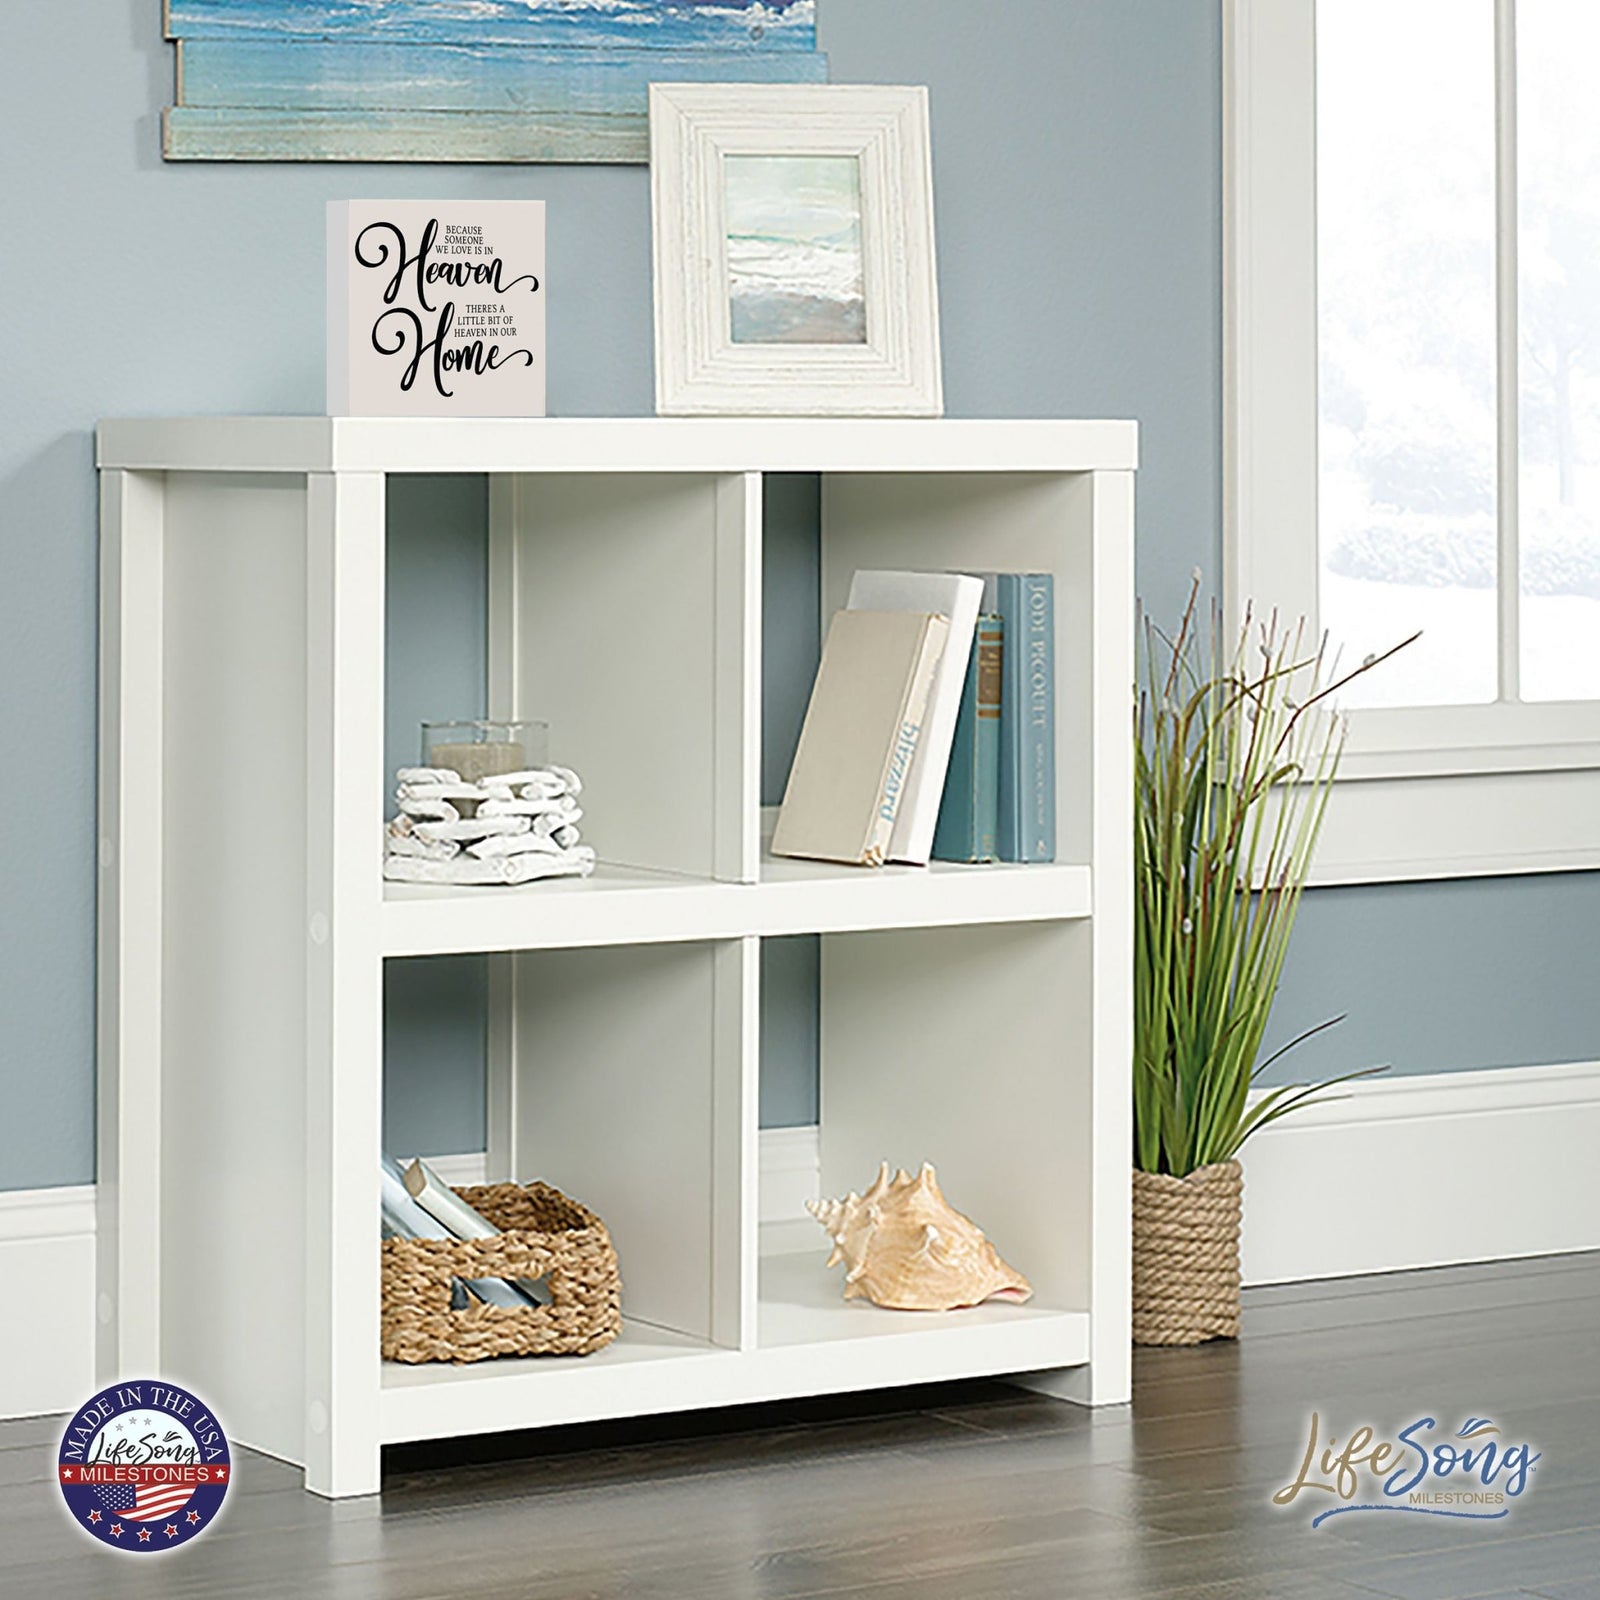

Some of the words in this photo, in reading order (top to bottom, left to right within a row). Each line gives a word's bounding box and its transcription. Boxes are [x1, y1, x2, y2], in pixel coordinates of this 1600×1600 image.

[445, 225, 483, 235] BECAUSE
[444, 235, 484, 245] SOMEONE
[435, 245, 450, 254] WE
[451, 245, 472, 255] LOVE
[474, 245, 483, 255] IS
[484, 246, 494, 255] IN
[355, 218, 539, 312] Heaven
[498, 304, 506, 313] A
[457, 316, 486, 325] LITTLE
[487, 316, 501, 325] BIT
[502, 316, 514, 325] OF
[454, 328, 488, 337] HEAVEN
[489, 328, 499, 337] IN
[500, 328, 517, 337] OUR
[371, 301, 533, 397] Home
[1028, 584, 1046, 632] JODI
